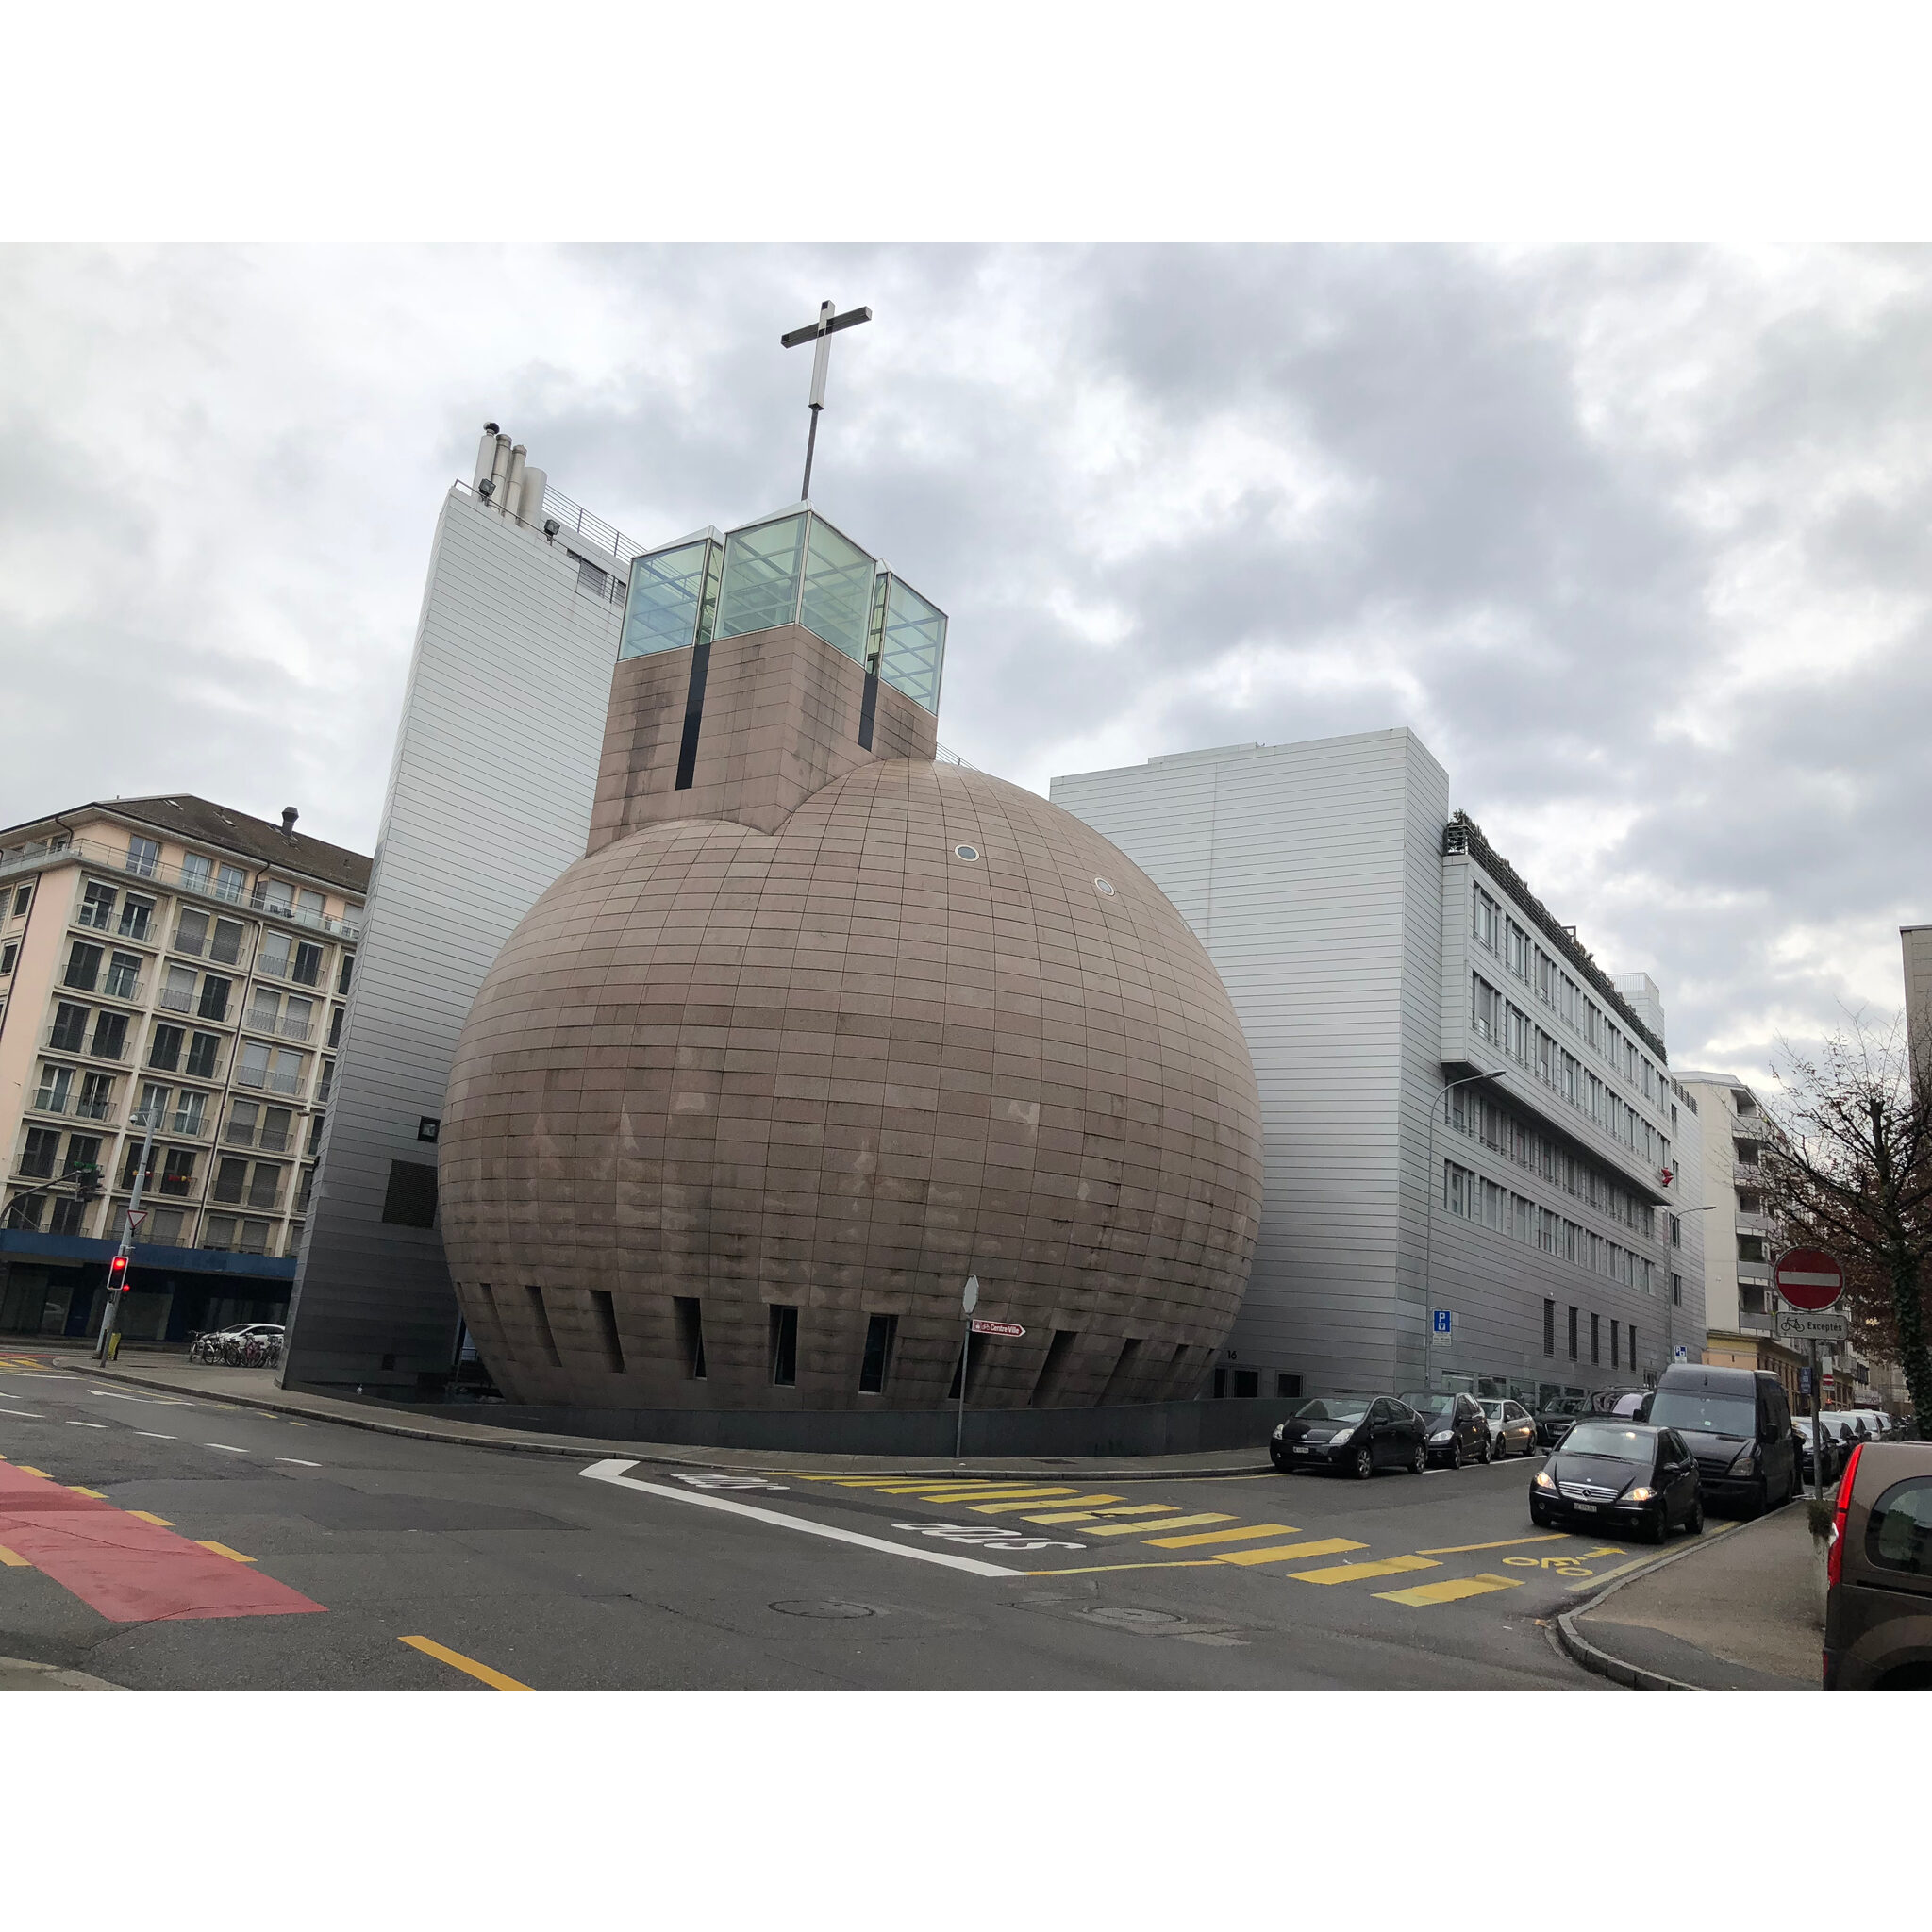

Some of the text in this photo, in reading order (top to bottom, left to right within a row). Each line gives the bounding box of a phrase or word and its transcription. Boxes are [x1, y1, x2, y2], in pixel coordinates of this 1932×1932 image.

[1439, 1312, 1446, 1323] P
[991, 1324, 1020, 1334] Centre Ville
[1807, 1322, 1842, 1333] Exceptés
[1227, 1350, 1238, 1360] 16
[891, 1523, 1088, 1550] STOP
